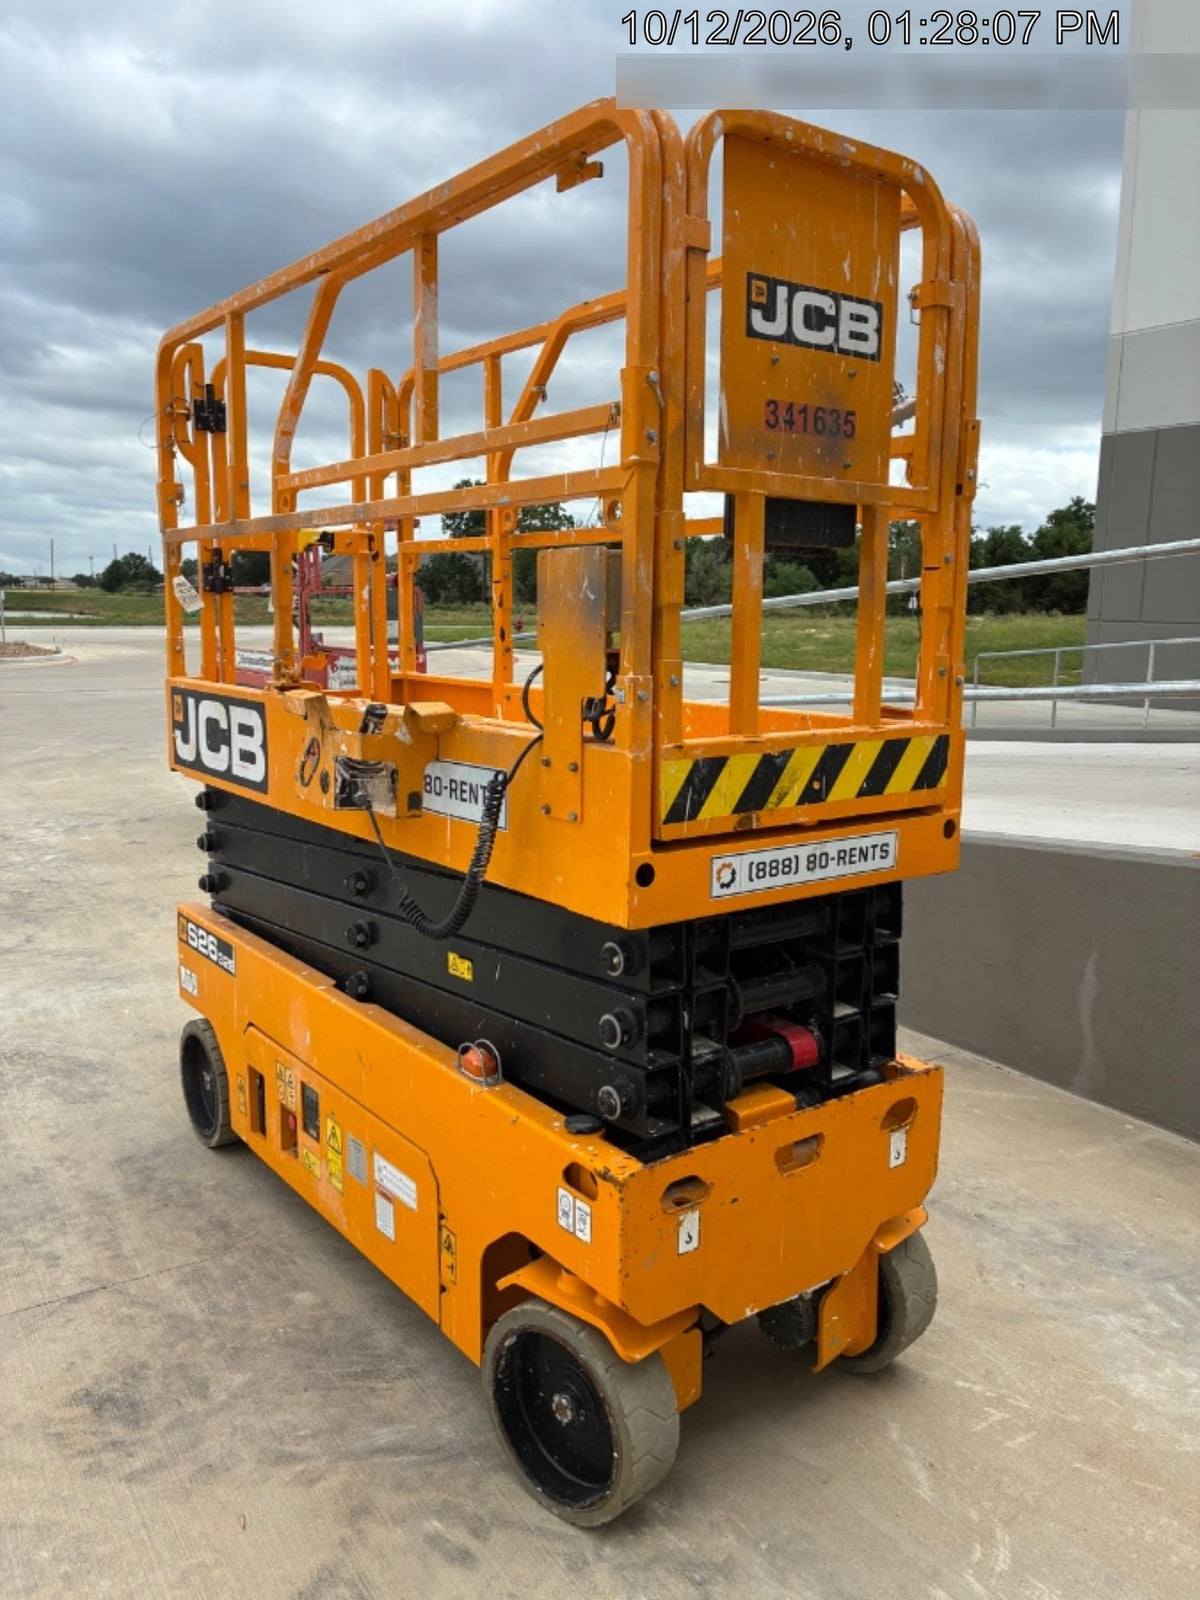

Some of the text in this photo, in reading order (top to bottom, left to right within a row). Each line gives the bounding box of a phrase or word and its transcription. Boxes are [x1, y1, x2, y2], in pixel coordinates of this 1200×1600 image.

[751, 285, 879, 355] JCB
[765, 400, 857, 439] 341635
[173, 696, 266, 783] JCB
[424, 774, 498, 806] 80-RENT
[748, 843, 890, 882] (888) 80-RENTS
